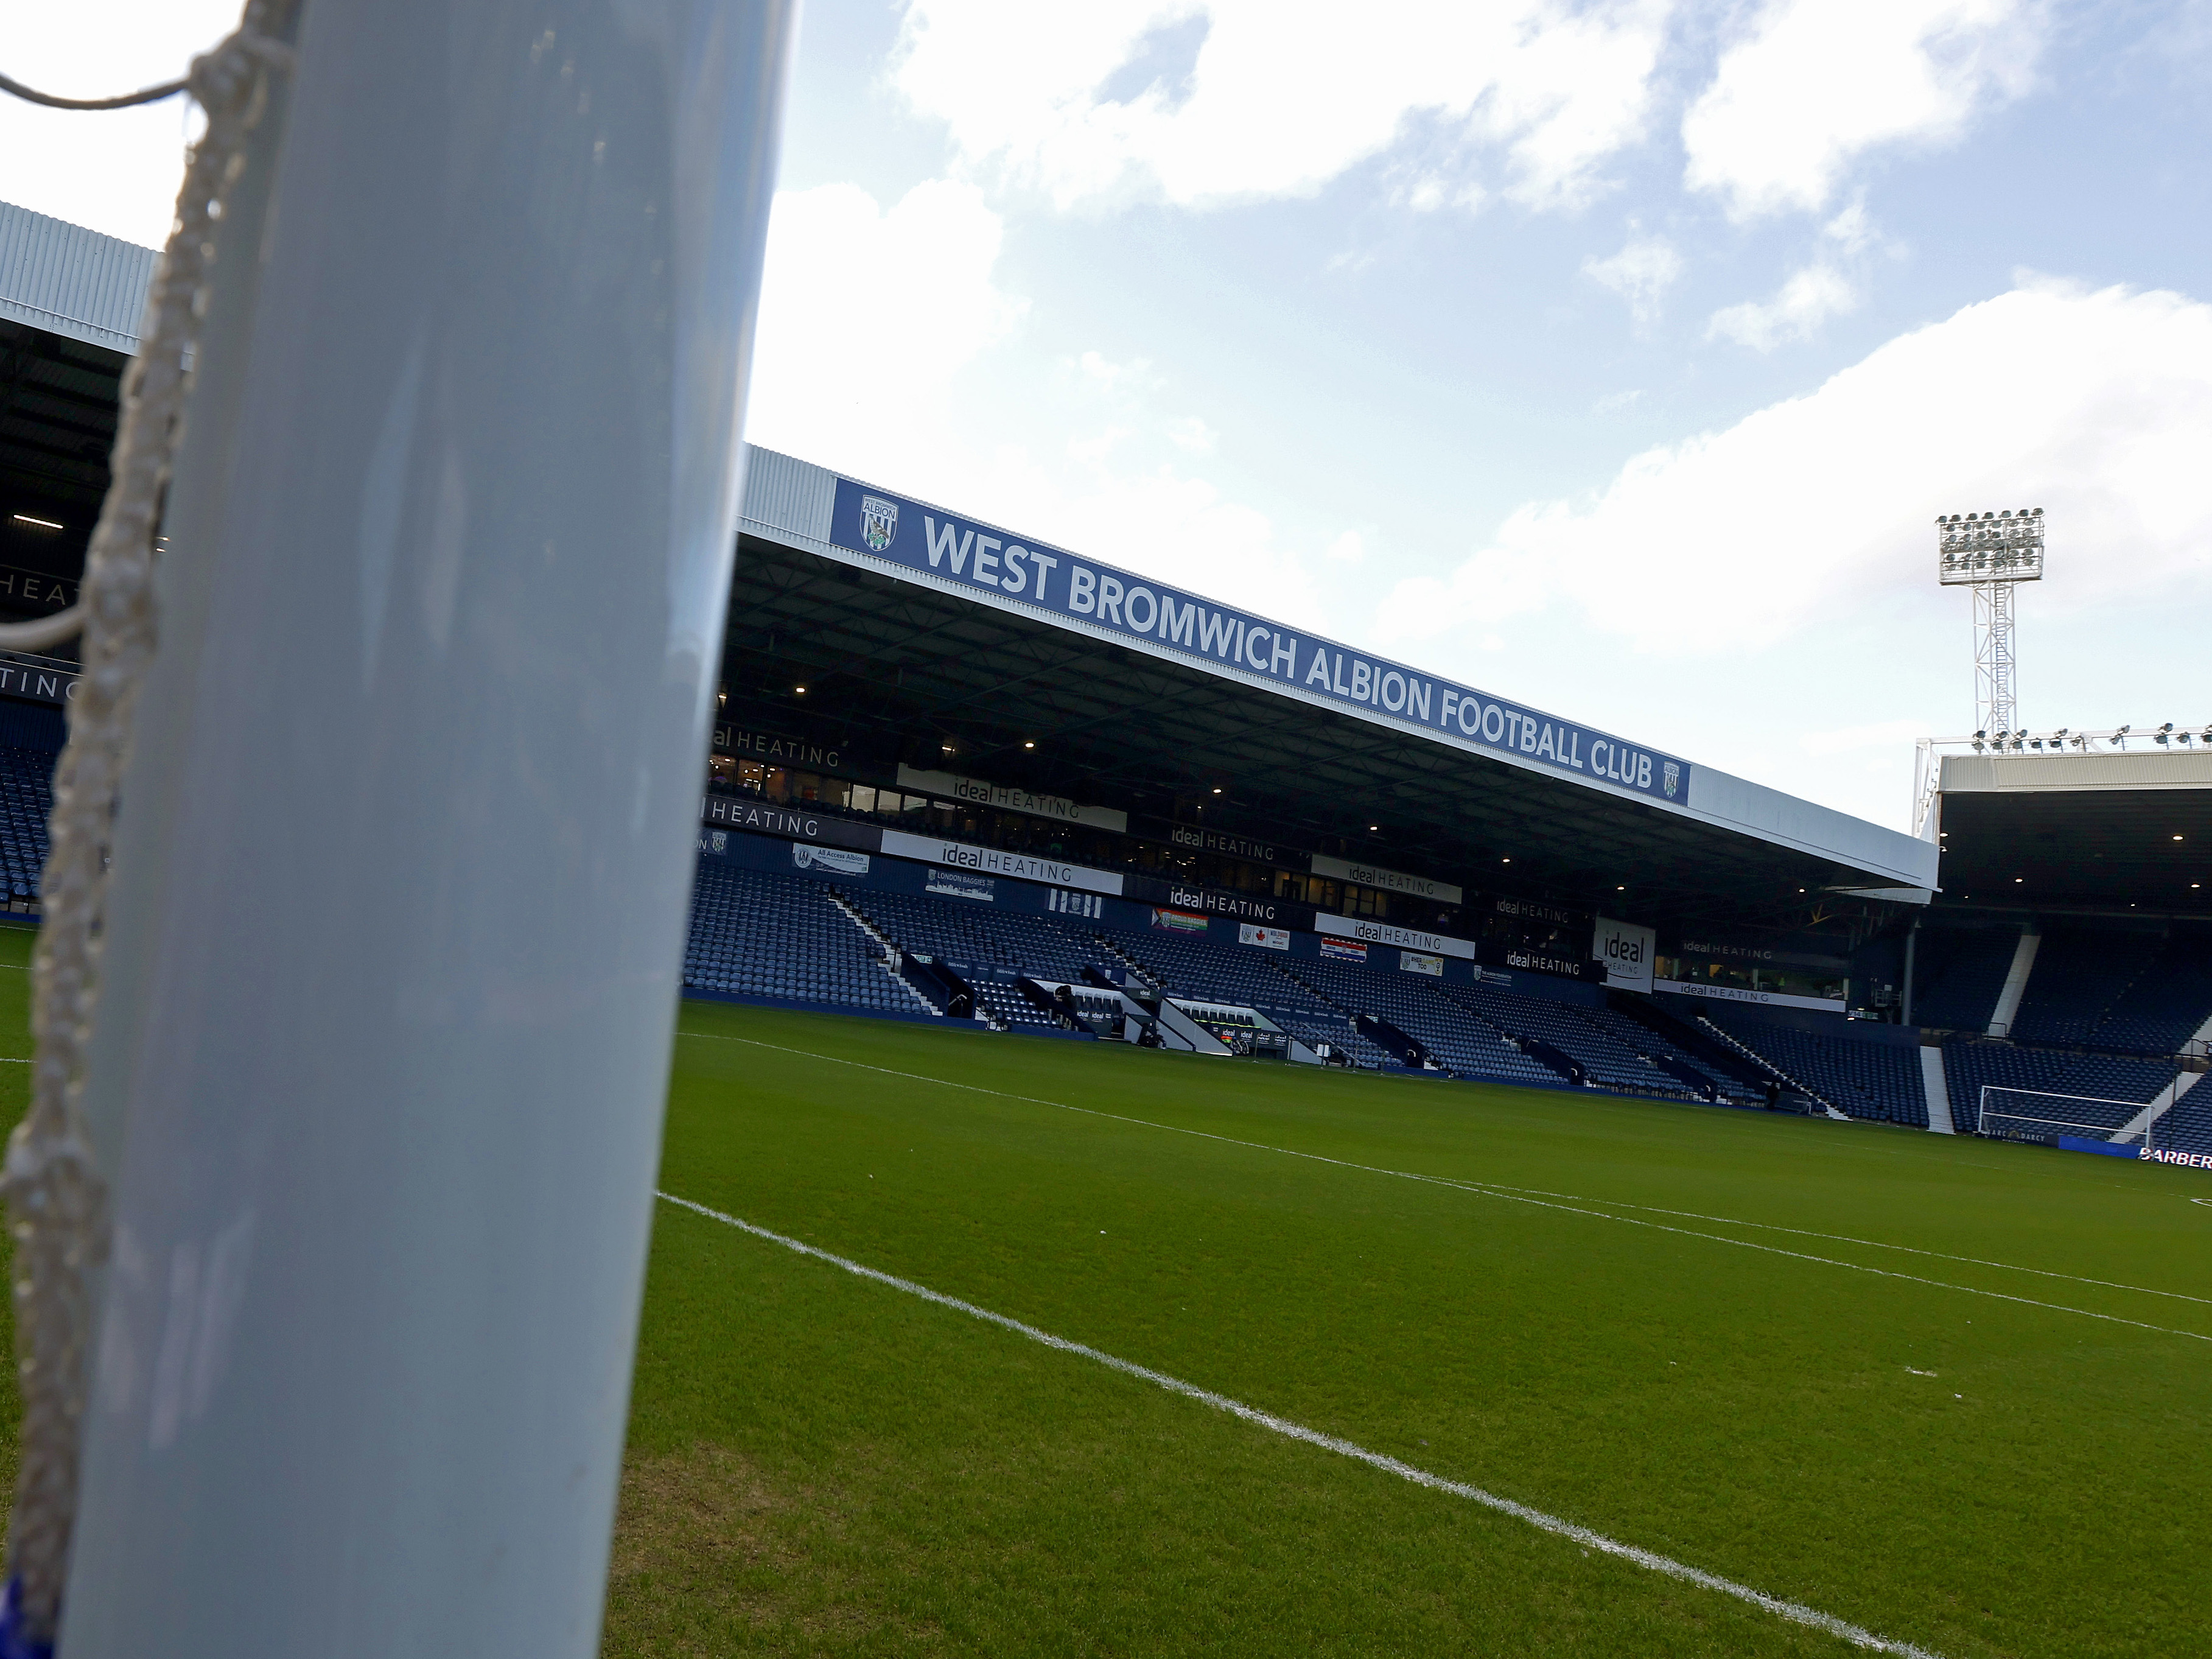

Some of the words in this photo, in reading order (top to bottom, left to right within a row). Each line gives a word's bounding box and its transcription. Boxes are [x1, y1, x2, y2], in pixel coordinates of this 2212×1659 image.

[864, 503, 895, 519] ALBION
[924, 516, 1057, 600] WEST
[1068, 565, 1297, 679] BROMWICH
[1306, 648, 1432, 721] ALBION
[1441, 689, 1583, 768] FOOTBALL
[1591, 740, 1652, 788] CLUB
[737, 731, 839, 767] HEATING
[954, 778, 993, 802] ideal
[998, 787, 1080, 819] HEATING
[712, 801, 818, 836] HEATING
[1171, 826, 1203, 847] ideal
[1207, 835, 1273, 861] HEATING
[846, 854, 864, 862] Albion
[942, 843, 982, 868] ideal
[987, 854, 1071, 882] HEATING
[937, 872, 962, 882] LONDON
[963, 877, 985, 886] BAGGIES
[1349, 866, 1375, 883] ideal
[1379, 871, 1433, 895] HEATING
[1170, 886, 1203, 908] ideal
[1206, 894, 1275, 920] HEATING
[1496, 898, 1519, 914] ideal
[1522, 904, 1569, 924] HEATING
[1355, 922, 1382, 941] ideal
[1385, 929, 1441, 950] HEATING
[1605, 931, 1643, 963] ideal
[1507, 950, 1529, 968] ideal
[1531, 956, 1580, 975] HEATING
[1683, 941, 1710, 953] ideal
[1713, 945, 1772, 960] HEATING
[1608, 963, 1637, 974] HEATING
[1681, 983, 1706, 995] ideal
[1710, 987, 1769, 1002] HEATING
[2021, 1133, 2045, 1142] DARCY
